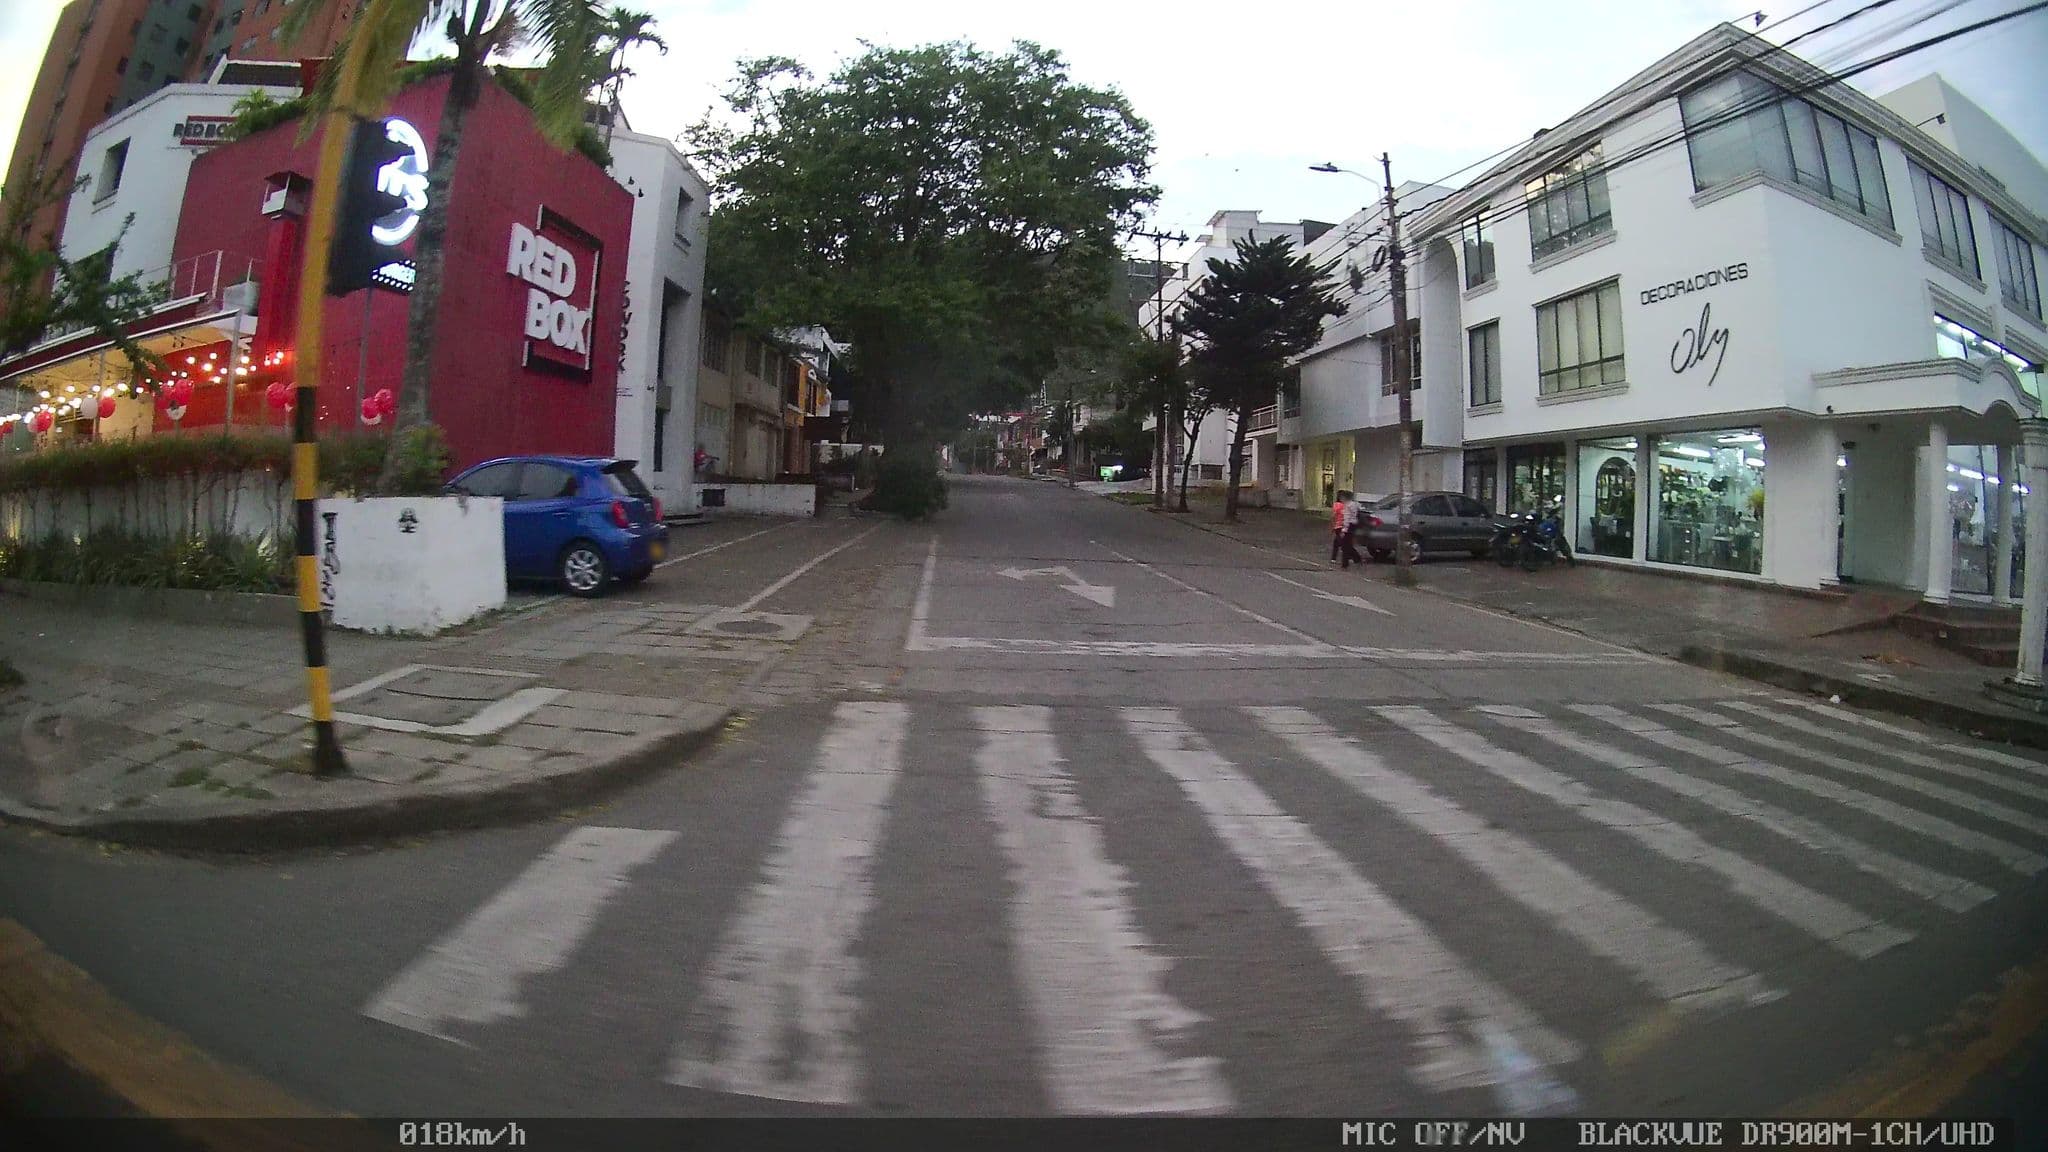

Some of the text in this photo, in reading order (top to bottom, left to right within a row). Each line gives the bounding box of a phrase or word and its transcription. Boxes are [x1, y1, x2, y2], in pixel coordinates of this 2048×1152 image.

[173, 122, 204, 138] RED
[506, 222, 577, 298] RED
[1640, 262, 1748, 305] DECORACIONES
[524, 288, 592, 355] BOX
